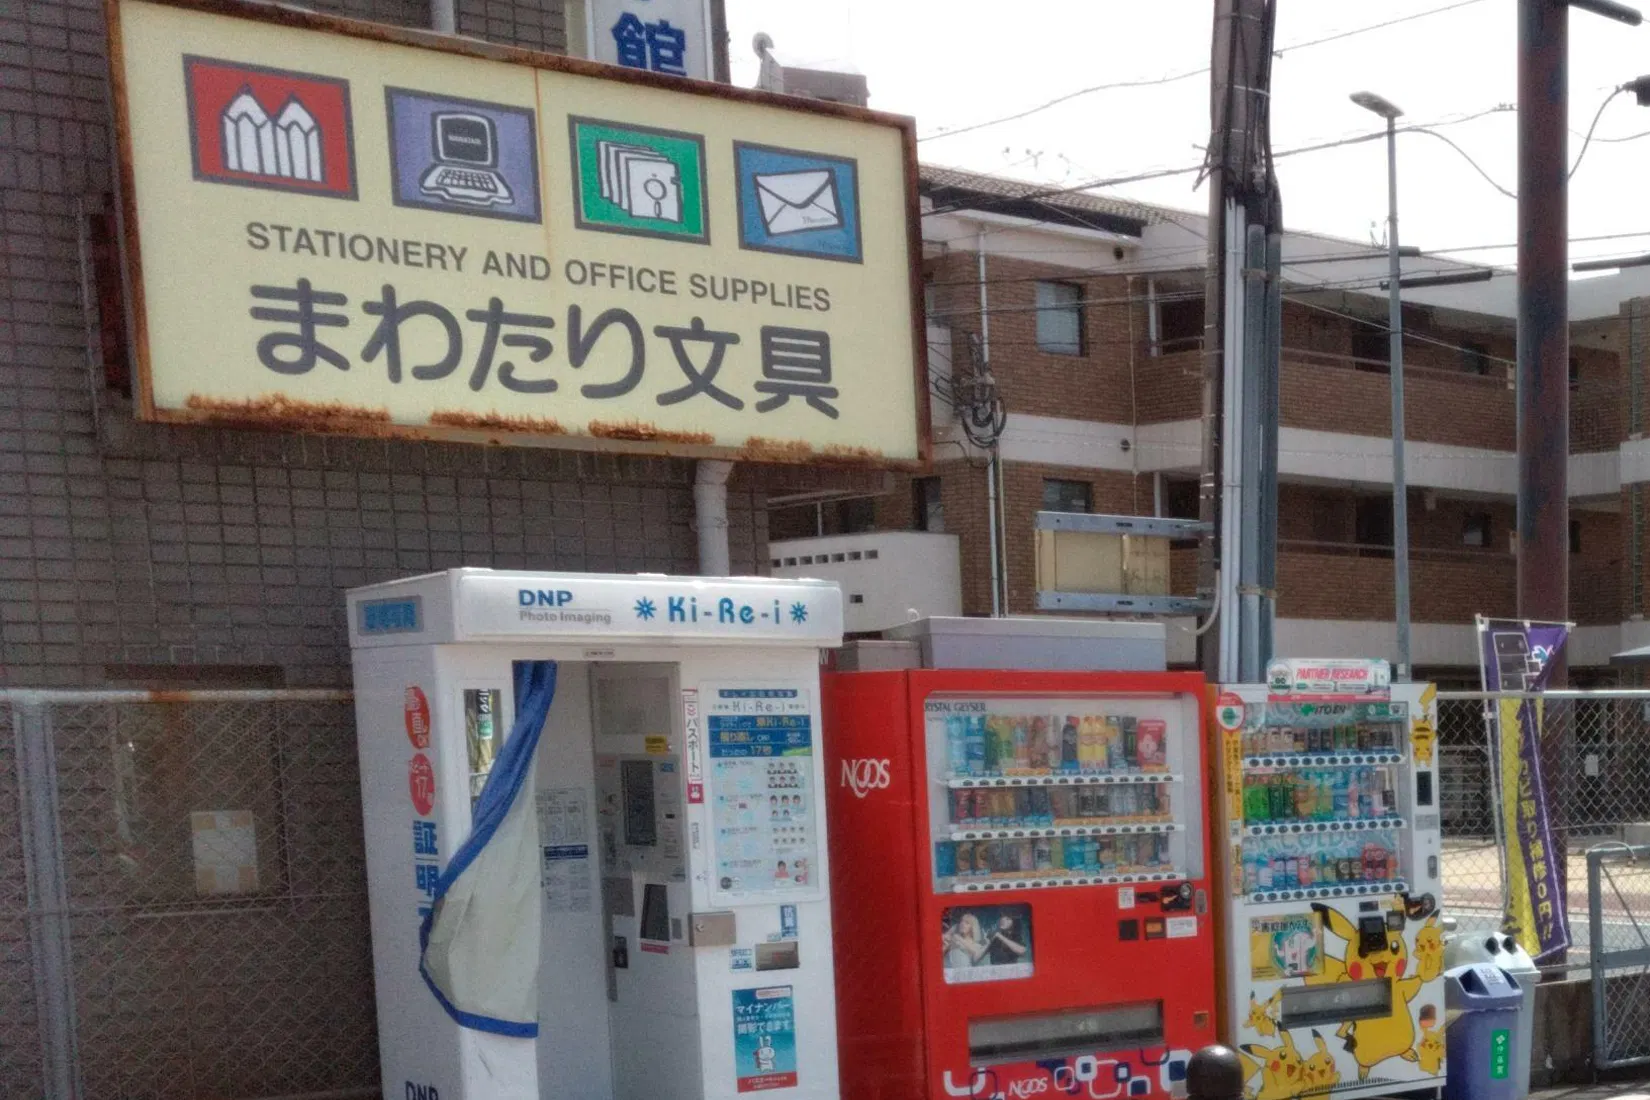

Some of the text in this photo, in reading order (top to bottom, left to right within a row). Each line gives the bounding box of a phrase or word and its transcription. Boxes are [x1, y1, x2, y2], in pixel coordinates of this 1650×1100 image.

[611, 11, 687, 76] 館
[246, 222, 831, 313] STATIONERY AND OFFICE SUPPLIES
[250, 277, 839, 420] まわたり文具
[518, 589, 573, 607] DNP
[519, 611, 612, 624] Photo Imaging
[668, 597, 781, 627] Ki-Re-i
[925, 702, 951, 712] RYSTAL
[686, 718, 700, 773] パスポート
